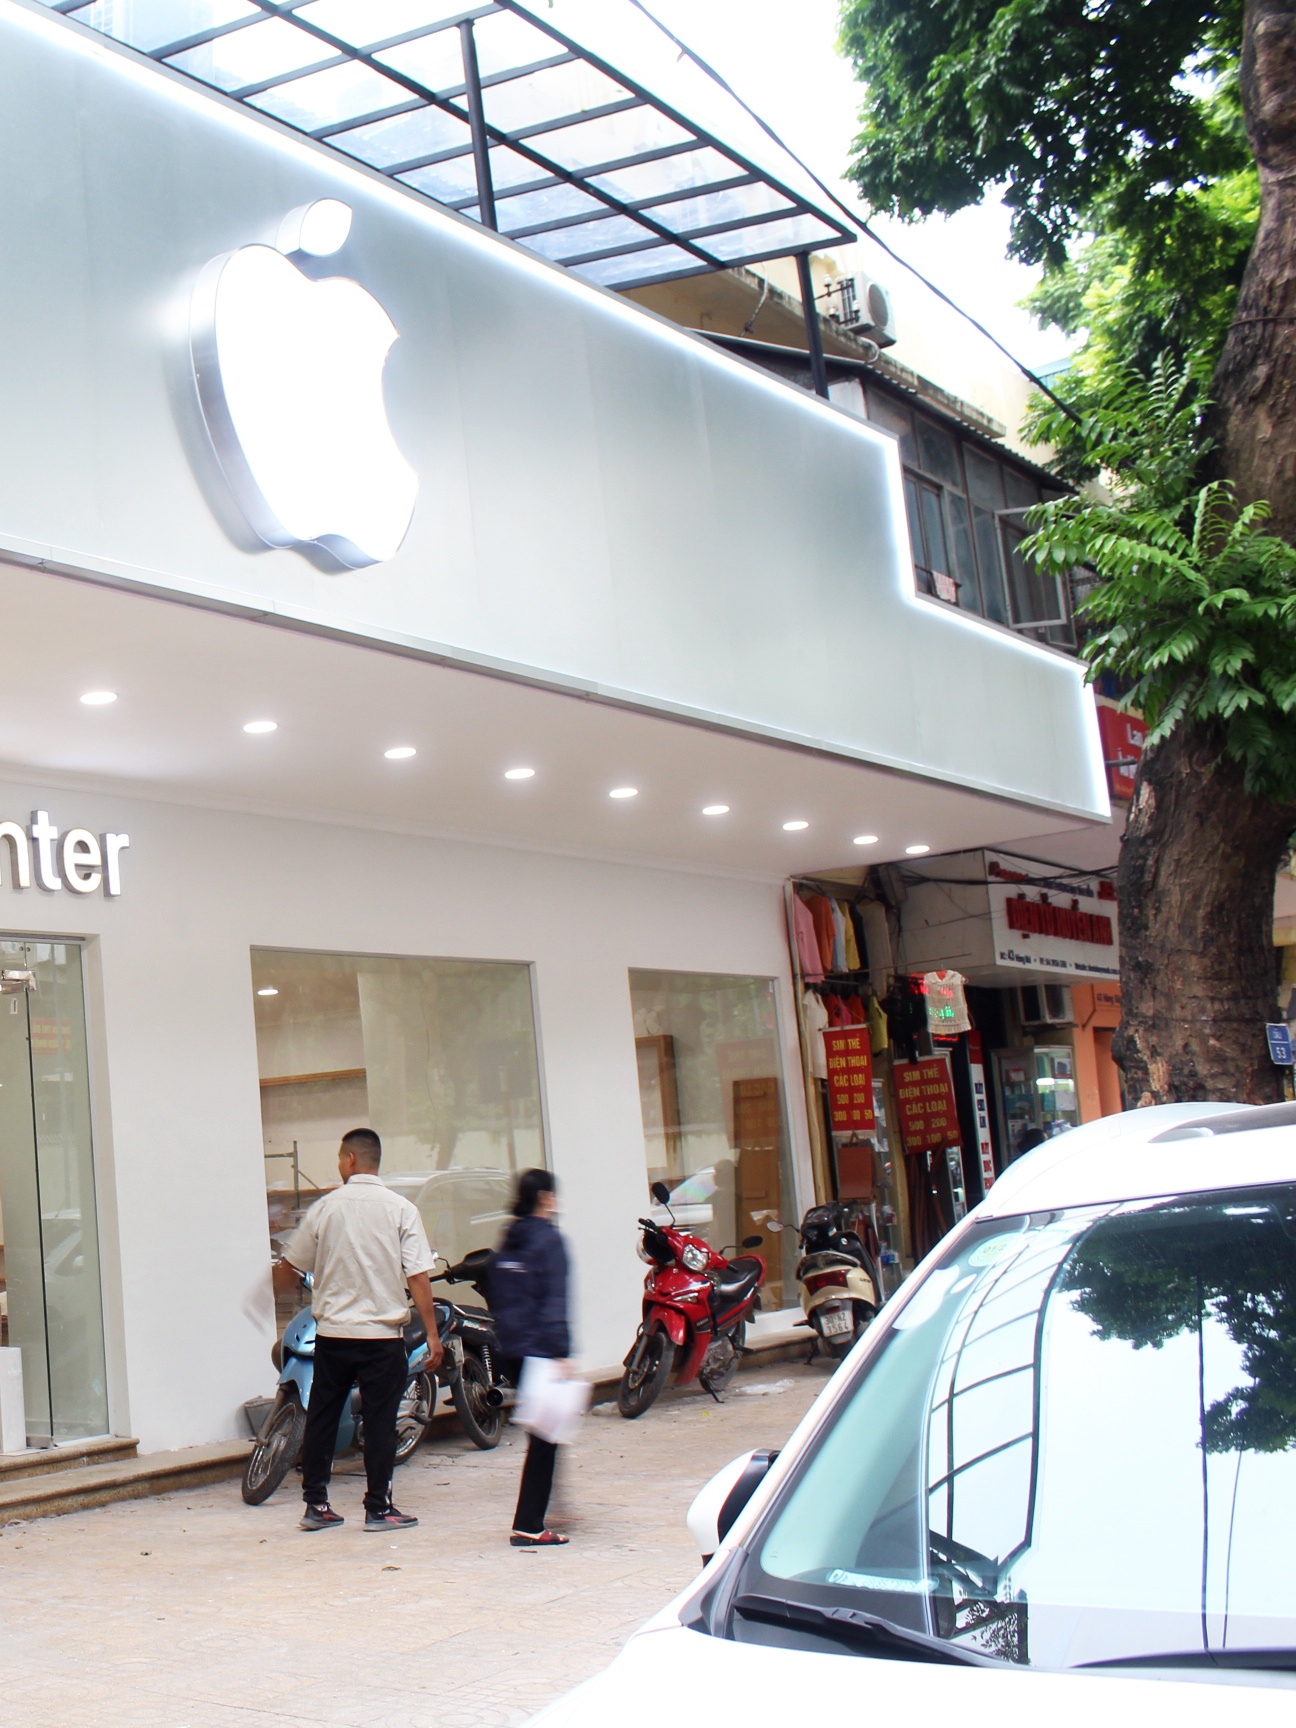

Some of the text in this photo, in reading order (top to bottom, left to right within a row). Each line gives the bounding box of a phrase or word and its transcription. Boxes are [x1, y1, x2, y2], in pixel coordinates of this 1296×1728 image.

[1276, 1047, 1287, 1059] 53
[847, 1055, 868, 1069] THOẠI
[903, 1070, 921, 1082] SIM
[899, 1083, 949, 1100] ĐIỆN THOẠI
[864, 1109, 873, 1120] 50
[906, 1100, 947, 1115] CÁC LOẠI
[908, 1117, 947, 1131] 500 200
[906, 1130, 958, 1147] 300 100 50
[827, 1322, 849, 1334] 3564
